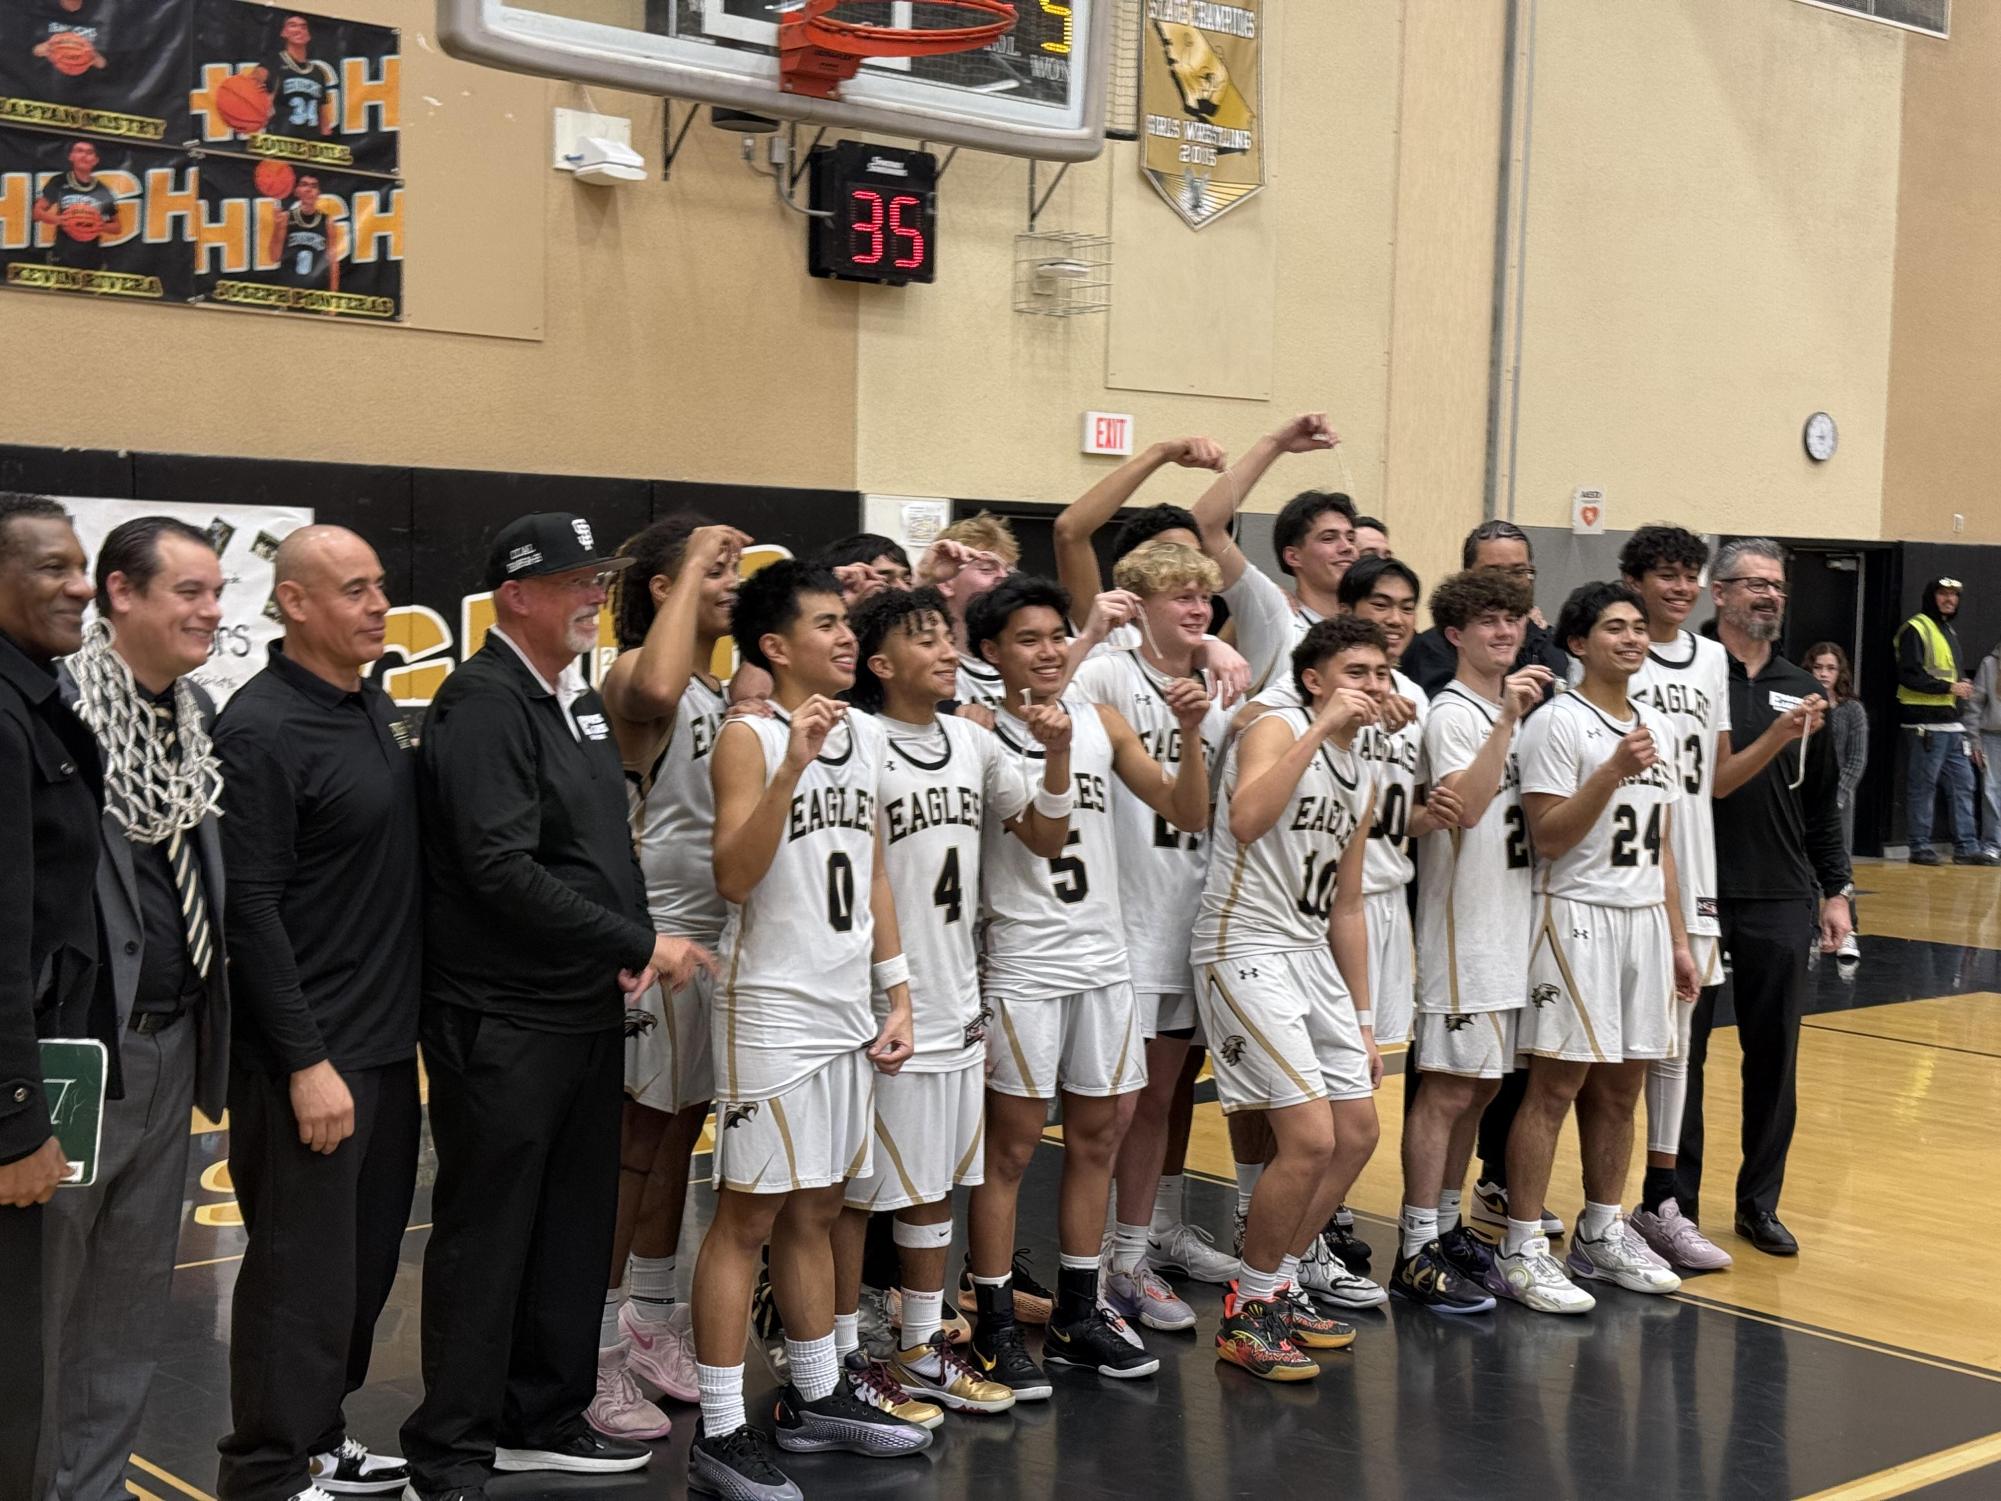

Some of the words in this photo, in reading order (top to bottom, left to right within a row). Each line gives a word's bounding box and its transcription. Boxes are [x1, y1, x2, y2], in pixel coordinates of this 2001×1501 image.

[851, 191, 924, 268] 35
[1096, 417, 1127, 449] EXIT
[1048, 828, 1088, 904] 5
[1611, 804, 1662, 868] 24
[827, 852, 854, 932] 0
[933, 846, 962, 925] 4
